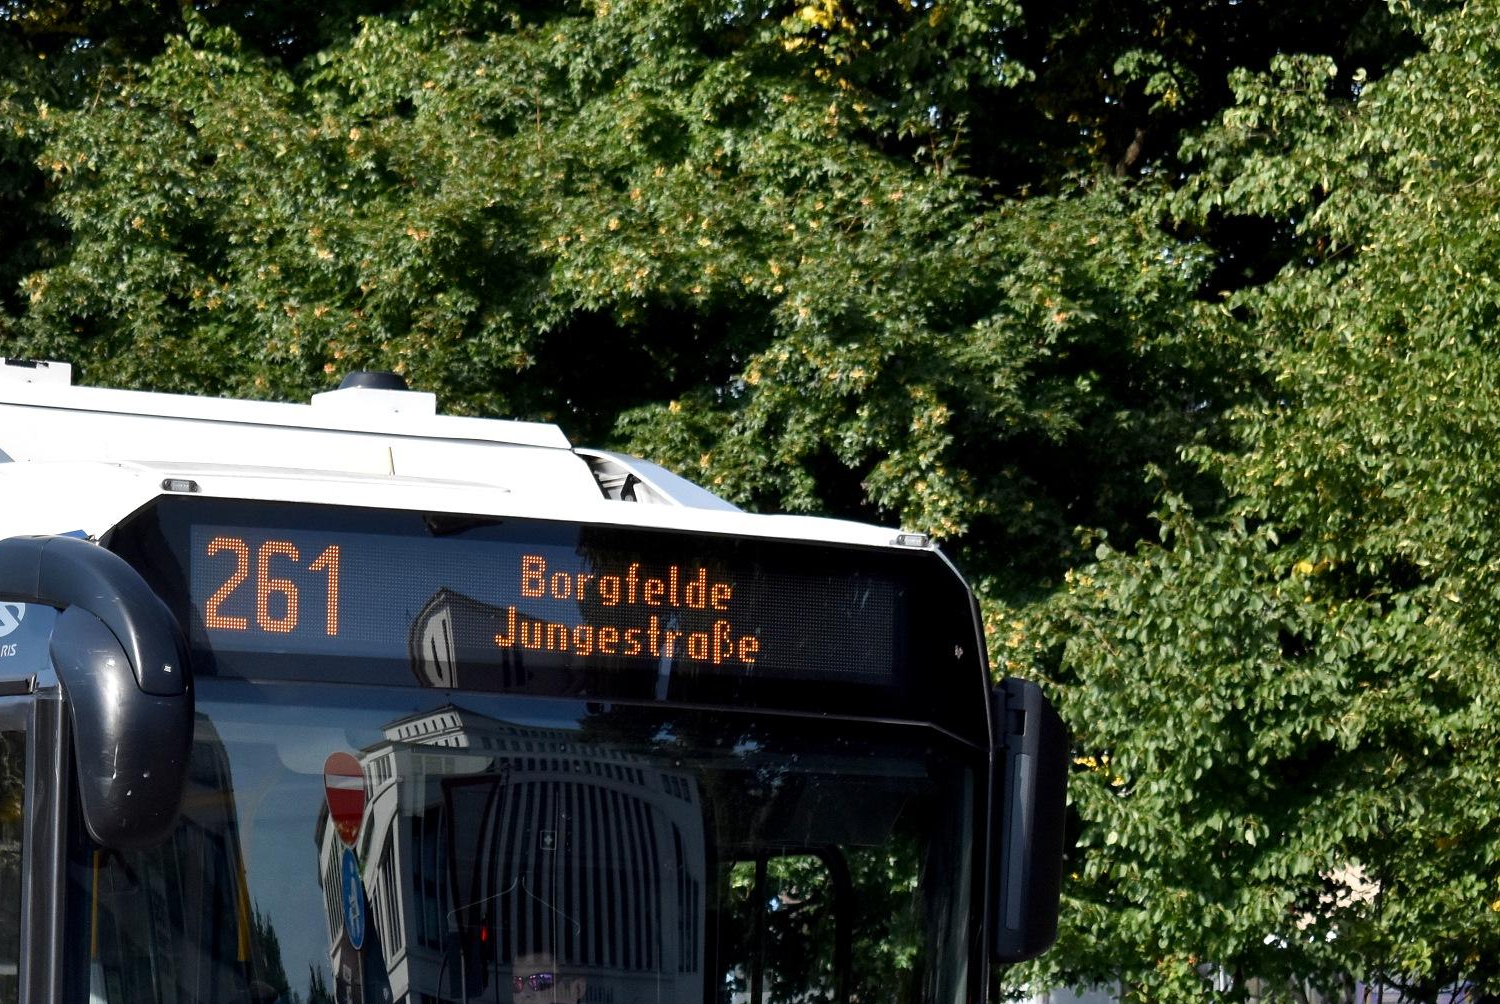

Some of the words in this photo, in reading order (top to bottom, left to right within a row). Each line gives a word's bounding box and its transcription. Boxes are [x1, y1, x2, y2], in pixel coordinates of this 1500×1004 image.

[205, 537, 340, 635] 261
[522, 554, 733, 611] Borgfelde
[494, 607, 760, 665] Jungestraße
